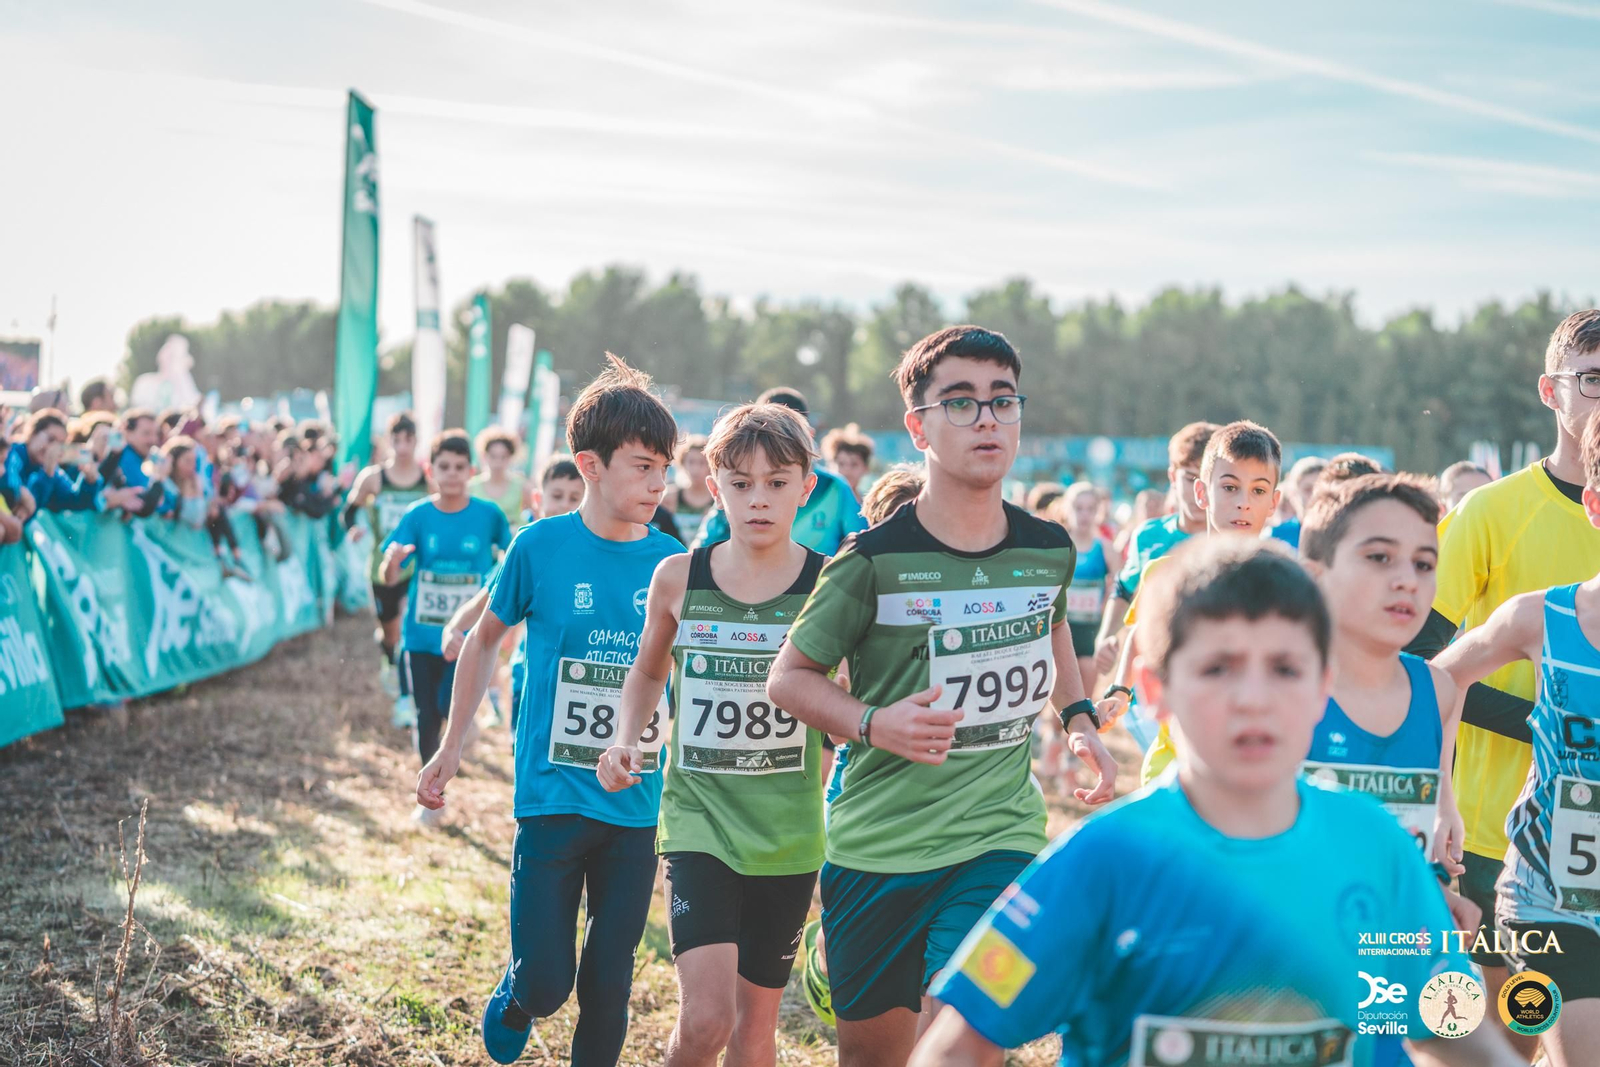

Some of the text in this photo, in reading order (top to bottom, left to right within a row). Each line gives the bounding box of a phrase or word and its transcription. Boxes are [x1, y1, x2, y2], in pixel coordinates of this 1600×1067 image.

[908, 572, 942, 580] IMDECO
[696, 605, 723, 613] IMDECO
[690, 631, 718, 639] CÓRDOBA
[971, 621, 1031, 643] ITÁLICA
[946, 659, 1049, 713] 7992
[564, 700, 660, 743] 583
[692, 698, 798, 740] 7989
[1348, 771, 1415, 795] ITÁLICA
[1567, 833, 1597, 876] 5
